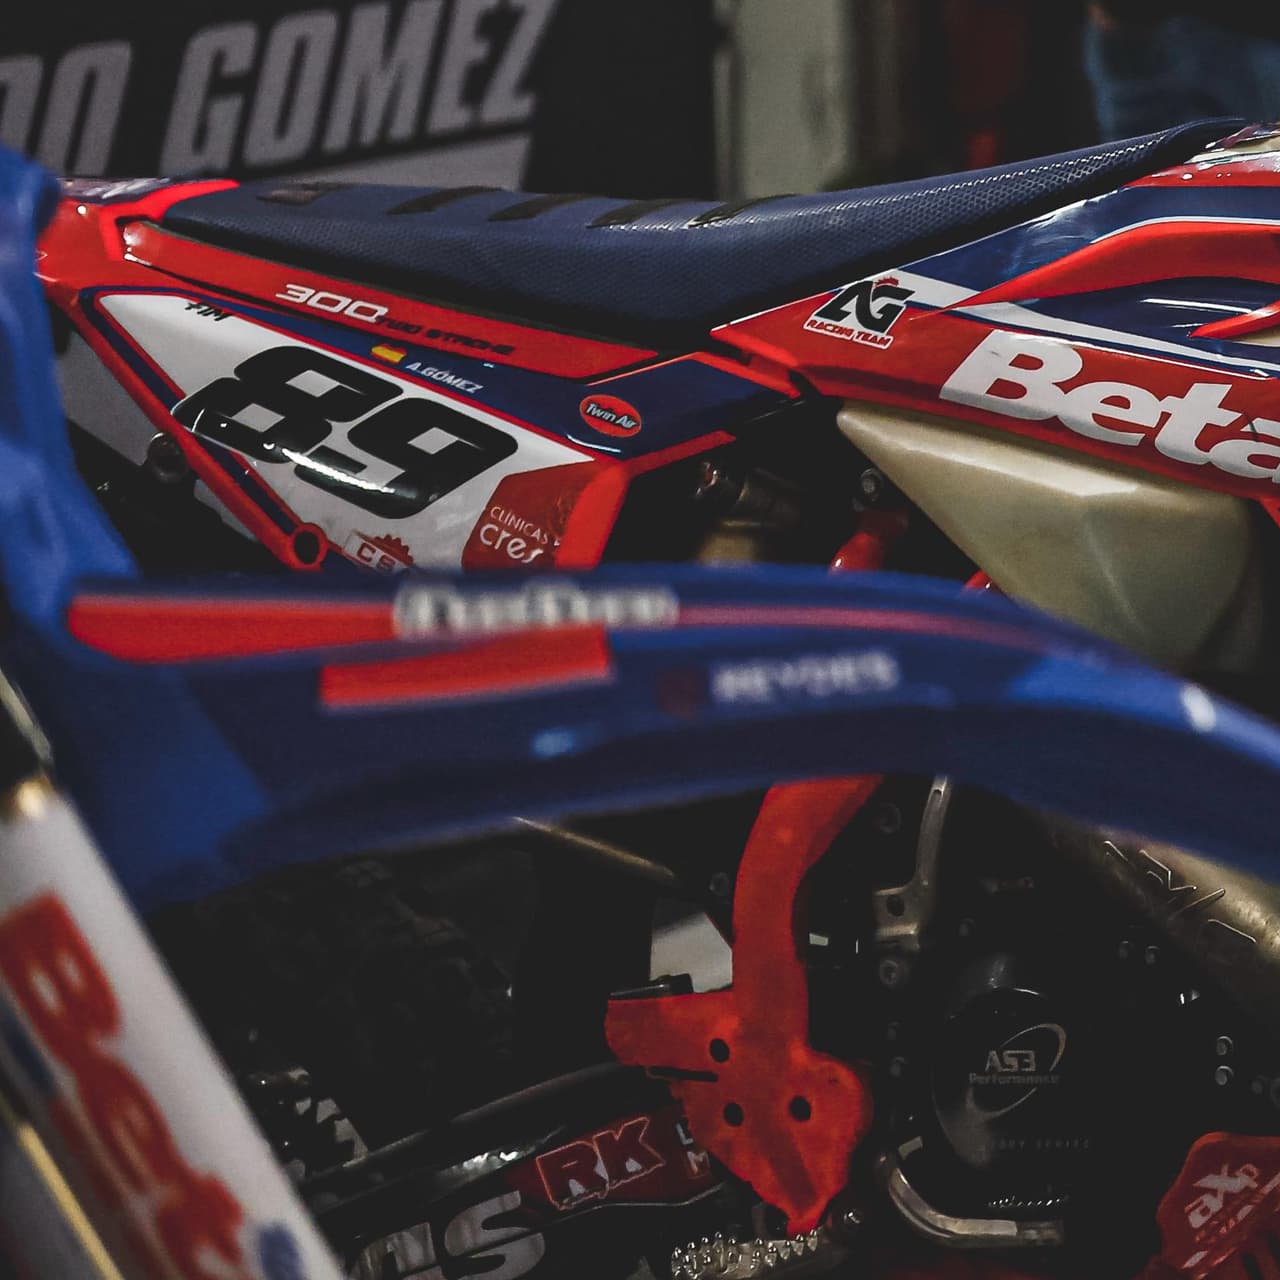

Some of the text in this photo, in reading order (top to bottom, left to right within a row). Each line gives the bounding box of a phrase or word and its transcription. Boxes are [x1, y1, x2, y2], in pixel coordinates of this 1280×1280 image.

[275, 283, 389, 322] 300
[172, 345, 519, 519] 89
[535, 1116, 666, 1212] RK
